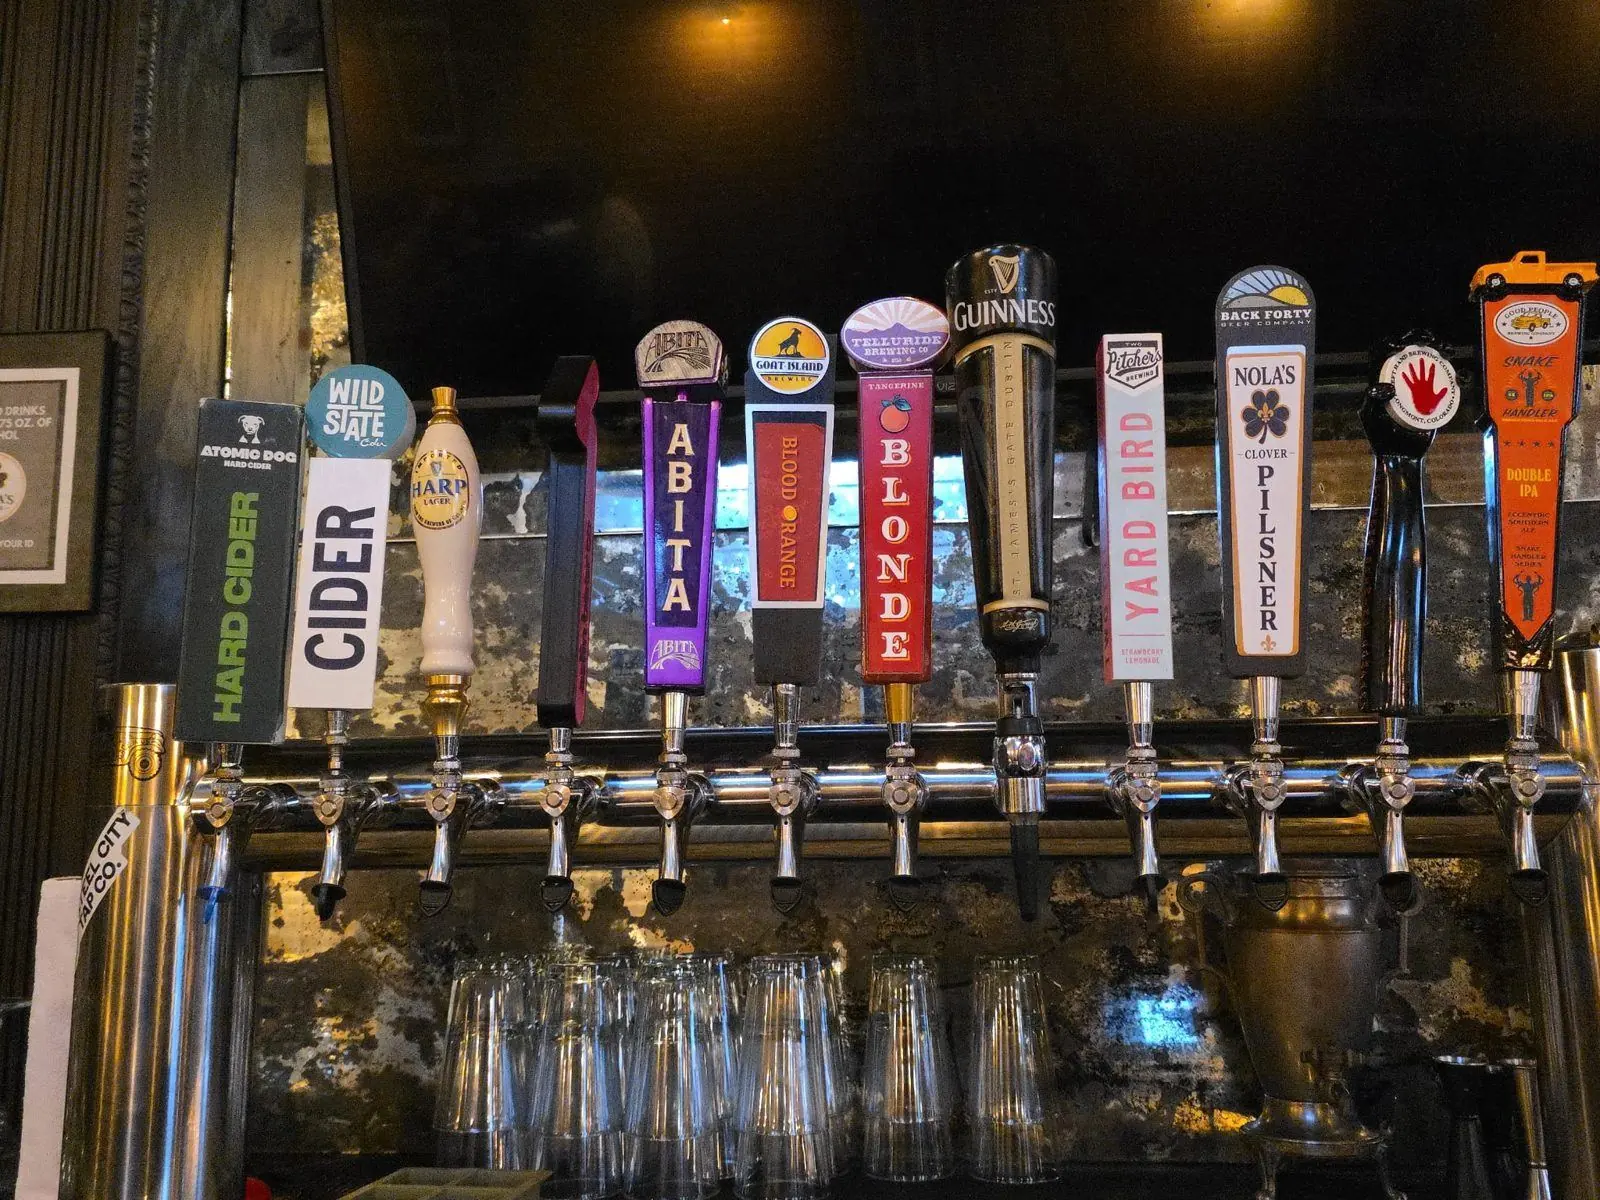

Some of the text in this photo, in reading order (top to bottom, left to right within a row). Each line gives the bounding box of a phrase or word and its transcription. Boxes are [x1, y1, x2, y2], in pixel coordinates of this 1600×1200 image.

[954, 299, 1055, 331] GUINNESS
[1221, 309, 1312, 321] BACK FORTY
[1504, 306, 1559, 319] GOOD PEOPLE
[645, 330, 709, 367] ABITA
[852, 335, 942, 348] TELLURIDE
[864, 346, 917, 356] BREWING
[1408, 350, 1439, 362] BREWING
[756, 360, 824, 372] GOAT ISLAND
[1105, 348, 1162, 375] Pitchers
[1503, 356, 1558, 368] SNAKE
[1003, 341, 1014, 409] DUBLIN
[1126, 370, 1154, 382] BREWING
[1235, 364, 1296, 386] NOLA'S
[329, 377, 385, 411] WILD
[868, 382, 925, 390] TANGERINE
[5, 405, 47, 416] DRINKS
[1502, 408, 1558, 418] HANDLER
[14, 417, 35, 428] OZ.
[36, 417, 53, 428] OF
[323, 404, 386, 442] STATE
[1005, 422, 1016, 465] GATE
[200, 445, 298, 463] ATOMIC DOG
[1244, 449, 1288, 460] CLOVER
[223, 460, 272, 470] HARD CIDER
[781, 436, 798, 501] BLOOD
[1506, 468, 1552, 482] DOUBLE
[412, 478, 467, 497] HARP
[1519, 484, 1539, 498] IPA
[423, 498, 452, 506] LAGER
[662, 423, 694, 612] ABITA
[1119, 412, 1159, 621] YARD BIRD
[24, 539, 35, 548] ID
[877, 439, 913, 661] BLONDE
[1257, 465, 1278, 630] PILSNER
[304, 505, 376, 671] CIDER
[213, 491, 260, 723] HARD CIDER
[650, 639, 700, 666] ABITA
[98, 808, 131, 858] CITY
[94, 861, 122, 894] CO.
